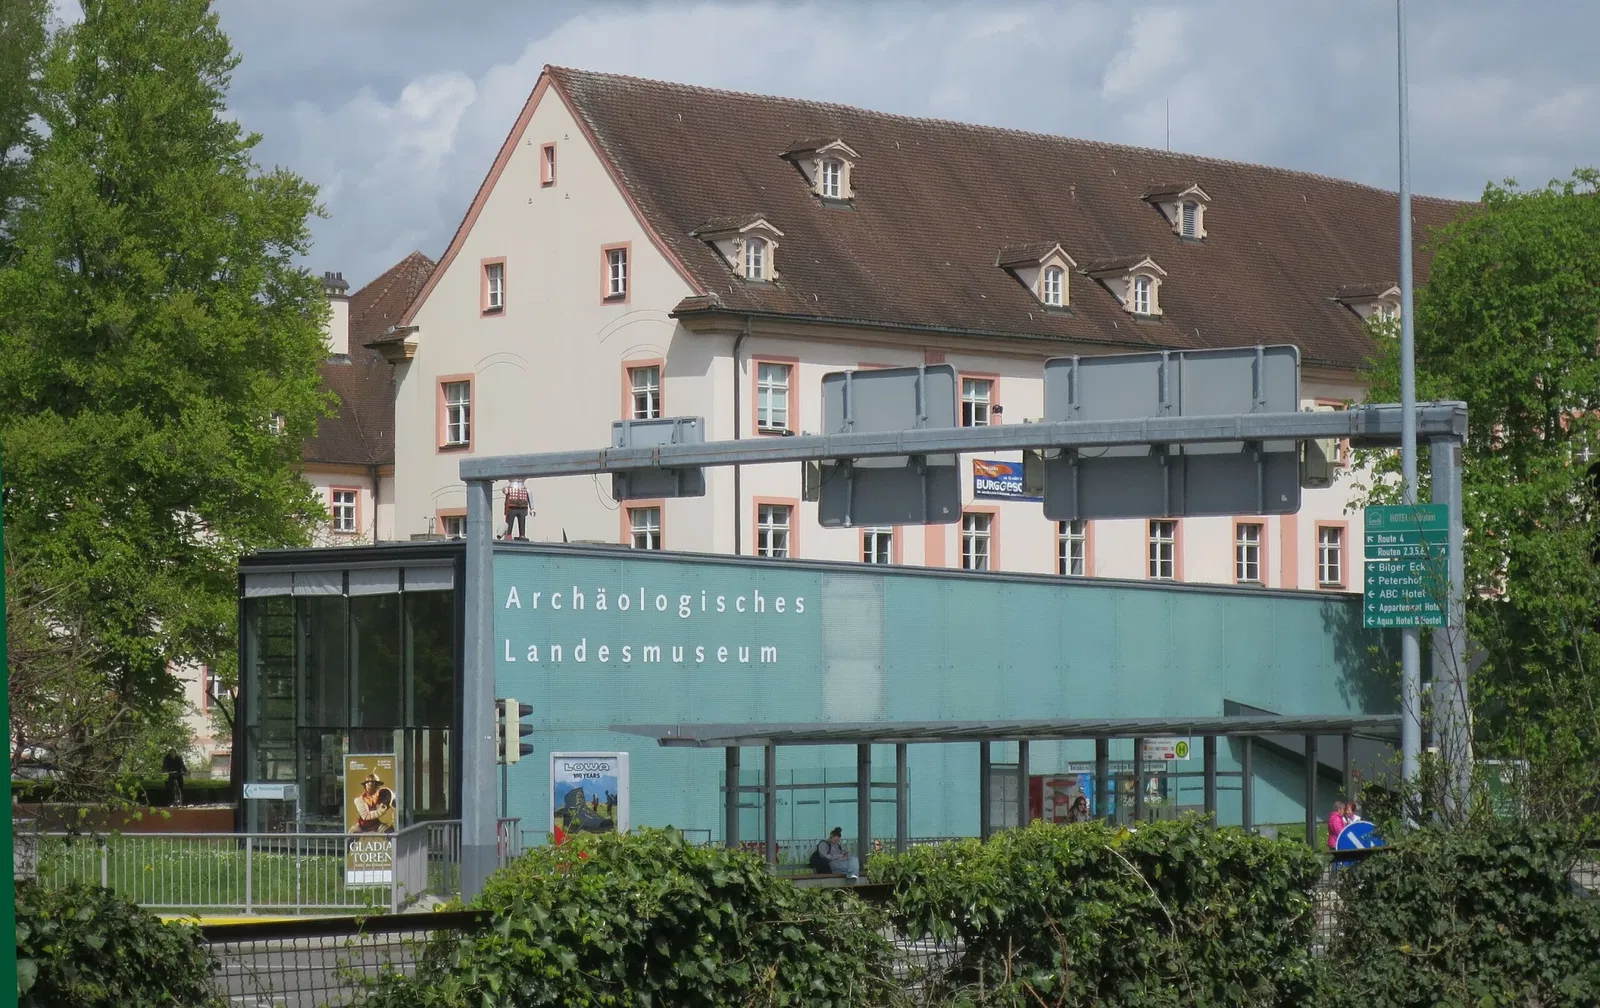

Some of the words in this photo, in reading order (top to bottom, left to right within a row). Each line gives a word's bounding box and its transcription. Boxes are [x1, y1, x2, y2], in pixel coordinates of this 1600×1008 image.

[1378, 534, 1397, 543] Route
[1399, 534, 1404, 543] 4
[1378, 547, 1401, 556] Routen
[1378, 563, 1405, 574] Bilger
[1410, 562, 1426, 572] Eck
[1378, 576, 1423, 585] Petershof
[1379, 589, 1398, 598] ABC
[1401, 589, 1426, 598] Hotel
[505, 585, 806, 619] Archäologisches
[1424, 602, 1440, 611] Hote
[1377, 616, 1393, 628] Aqua
[1396, 616, 1413, 625] Hotel
[504, 638, 778, 663] Landesmuseum
[564, 762, 610, 771] LOWA
[349, 841, 392, 852] GLADIA
[351, 852, 392, 863] TOREN
